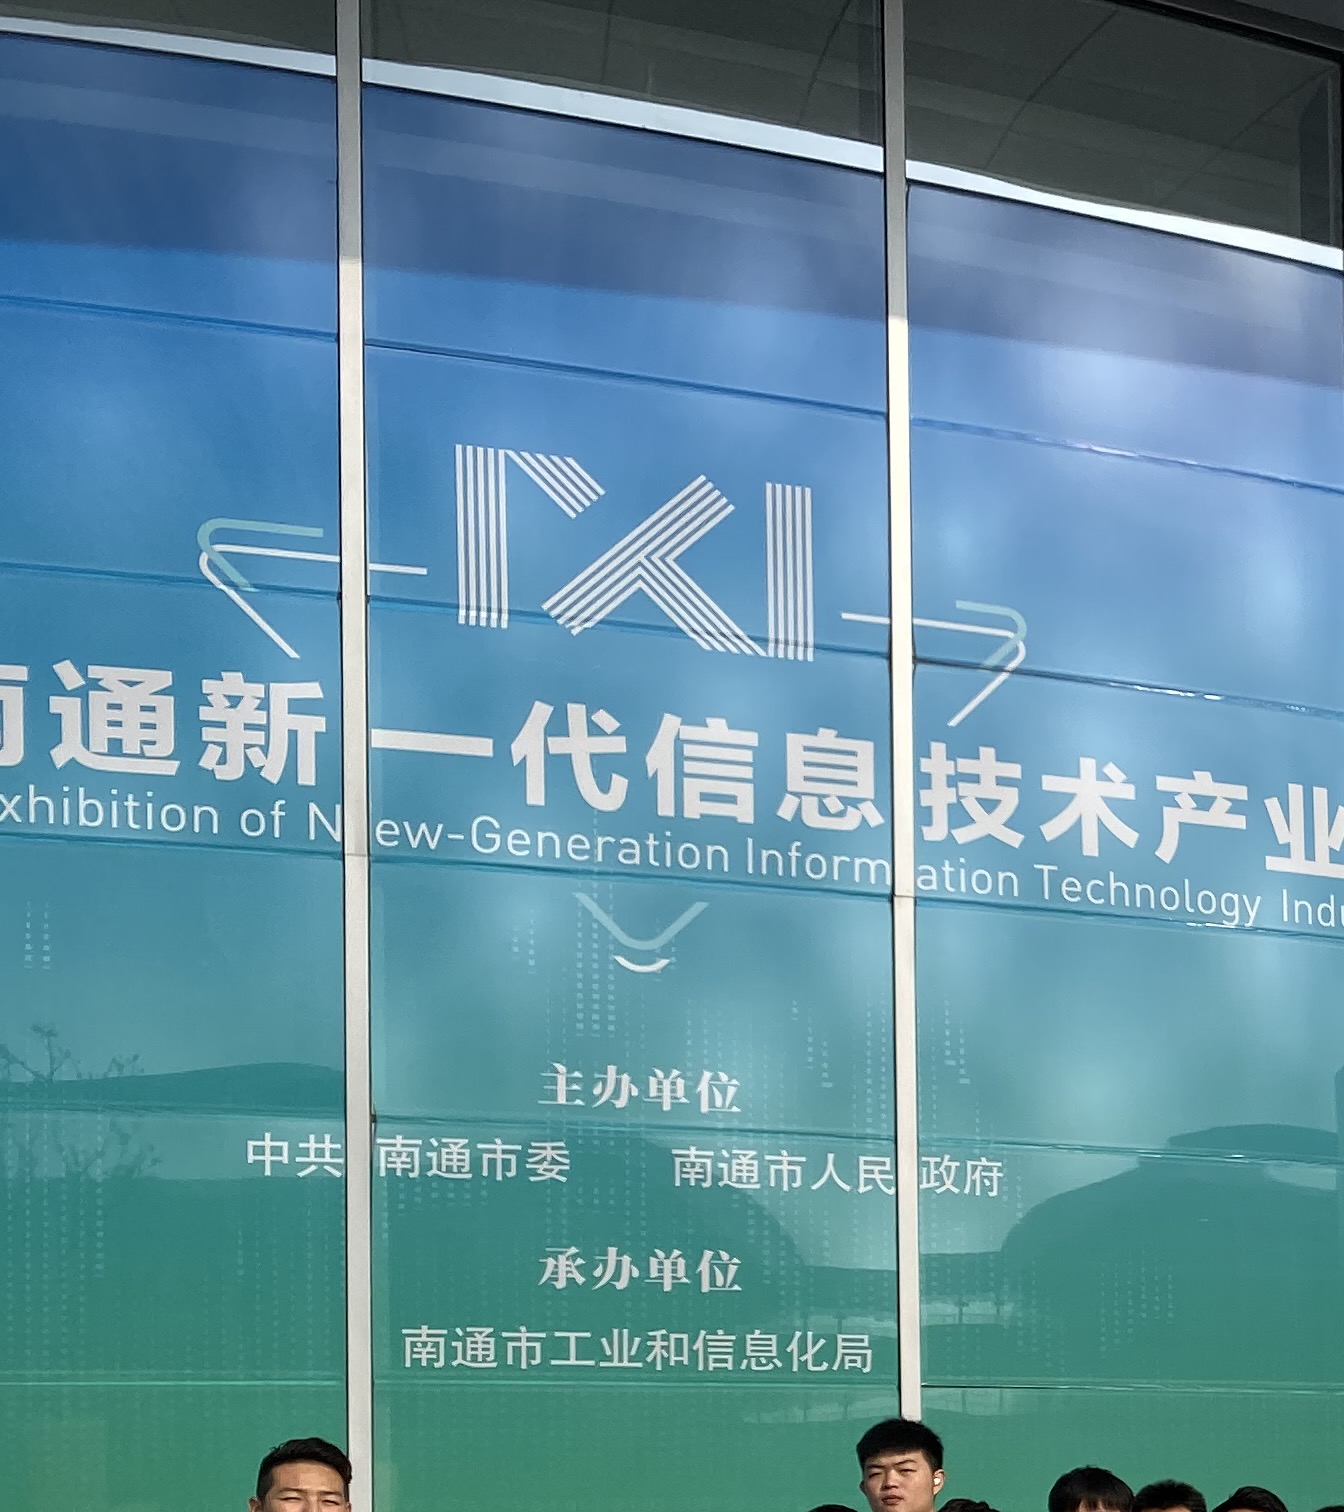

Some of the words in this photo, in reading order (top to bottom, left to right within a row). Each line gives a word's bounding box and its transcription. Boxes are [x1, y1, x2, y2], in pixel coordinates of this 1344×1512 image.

[240, 799, 287, 839] of
[309, 800, 729, 871] New-Generation
[747, 837, 1019, 897] Information
[1033, 864, 1261, 927] Technology
[538, 1062, 742, 1115] 主办单位
[246, 1132, 571, 1184] 中共南通市委
[671, 1145, 1004, 1198] 南通市人民政府
[537, 1246, 743, 1294] 承办单位
[400, 1325, 875, 1375] 南通市工业和信息化局
